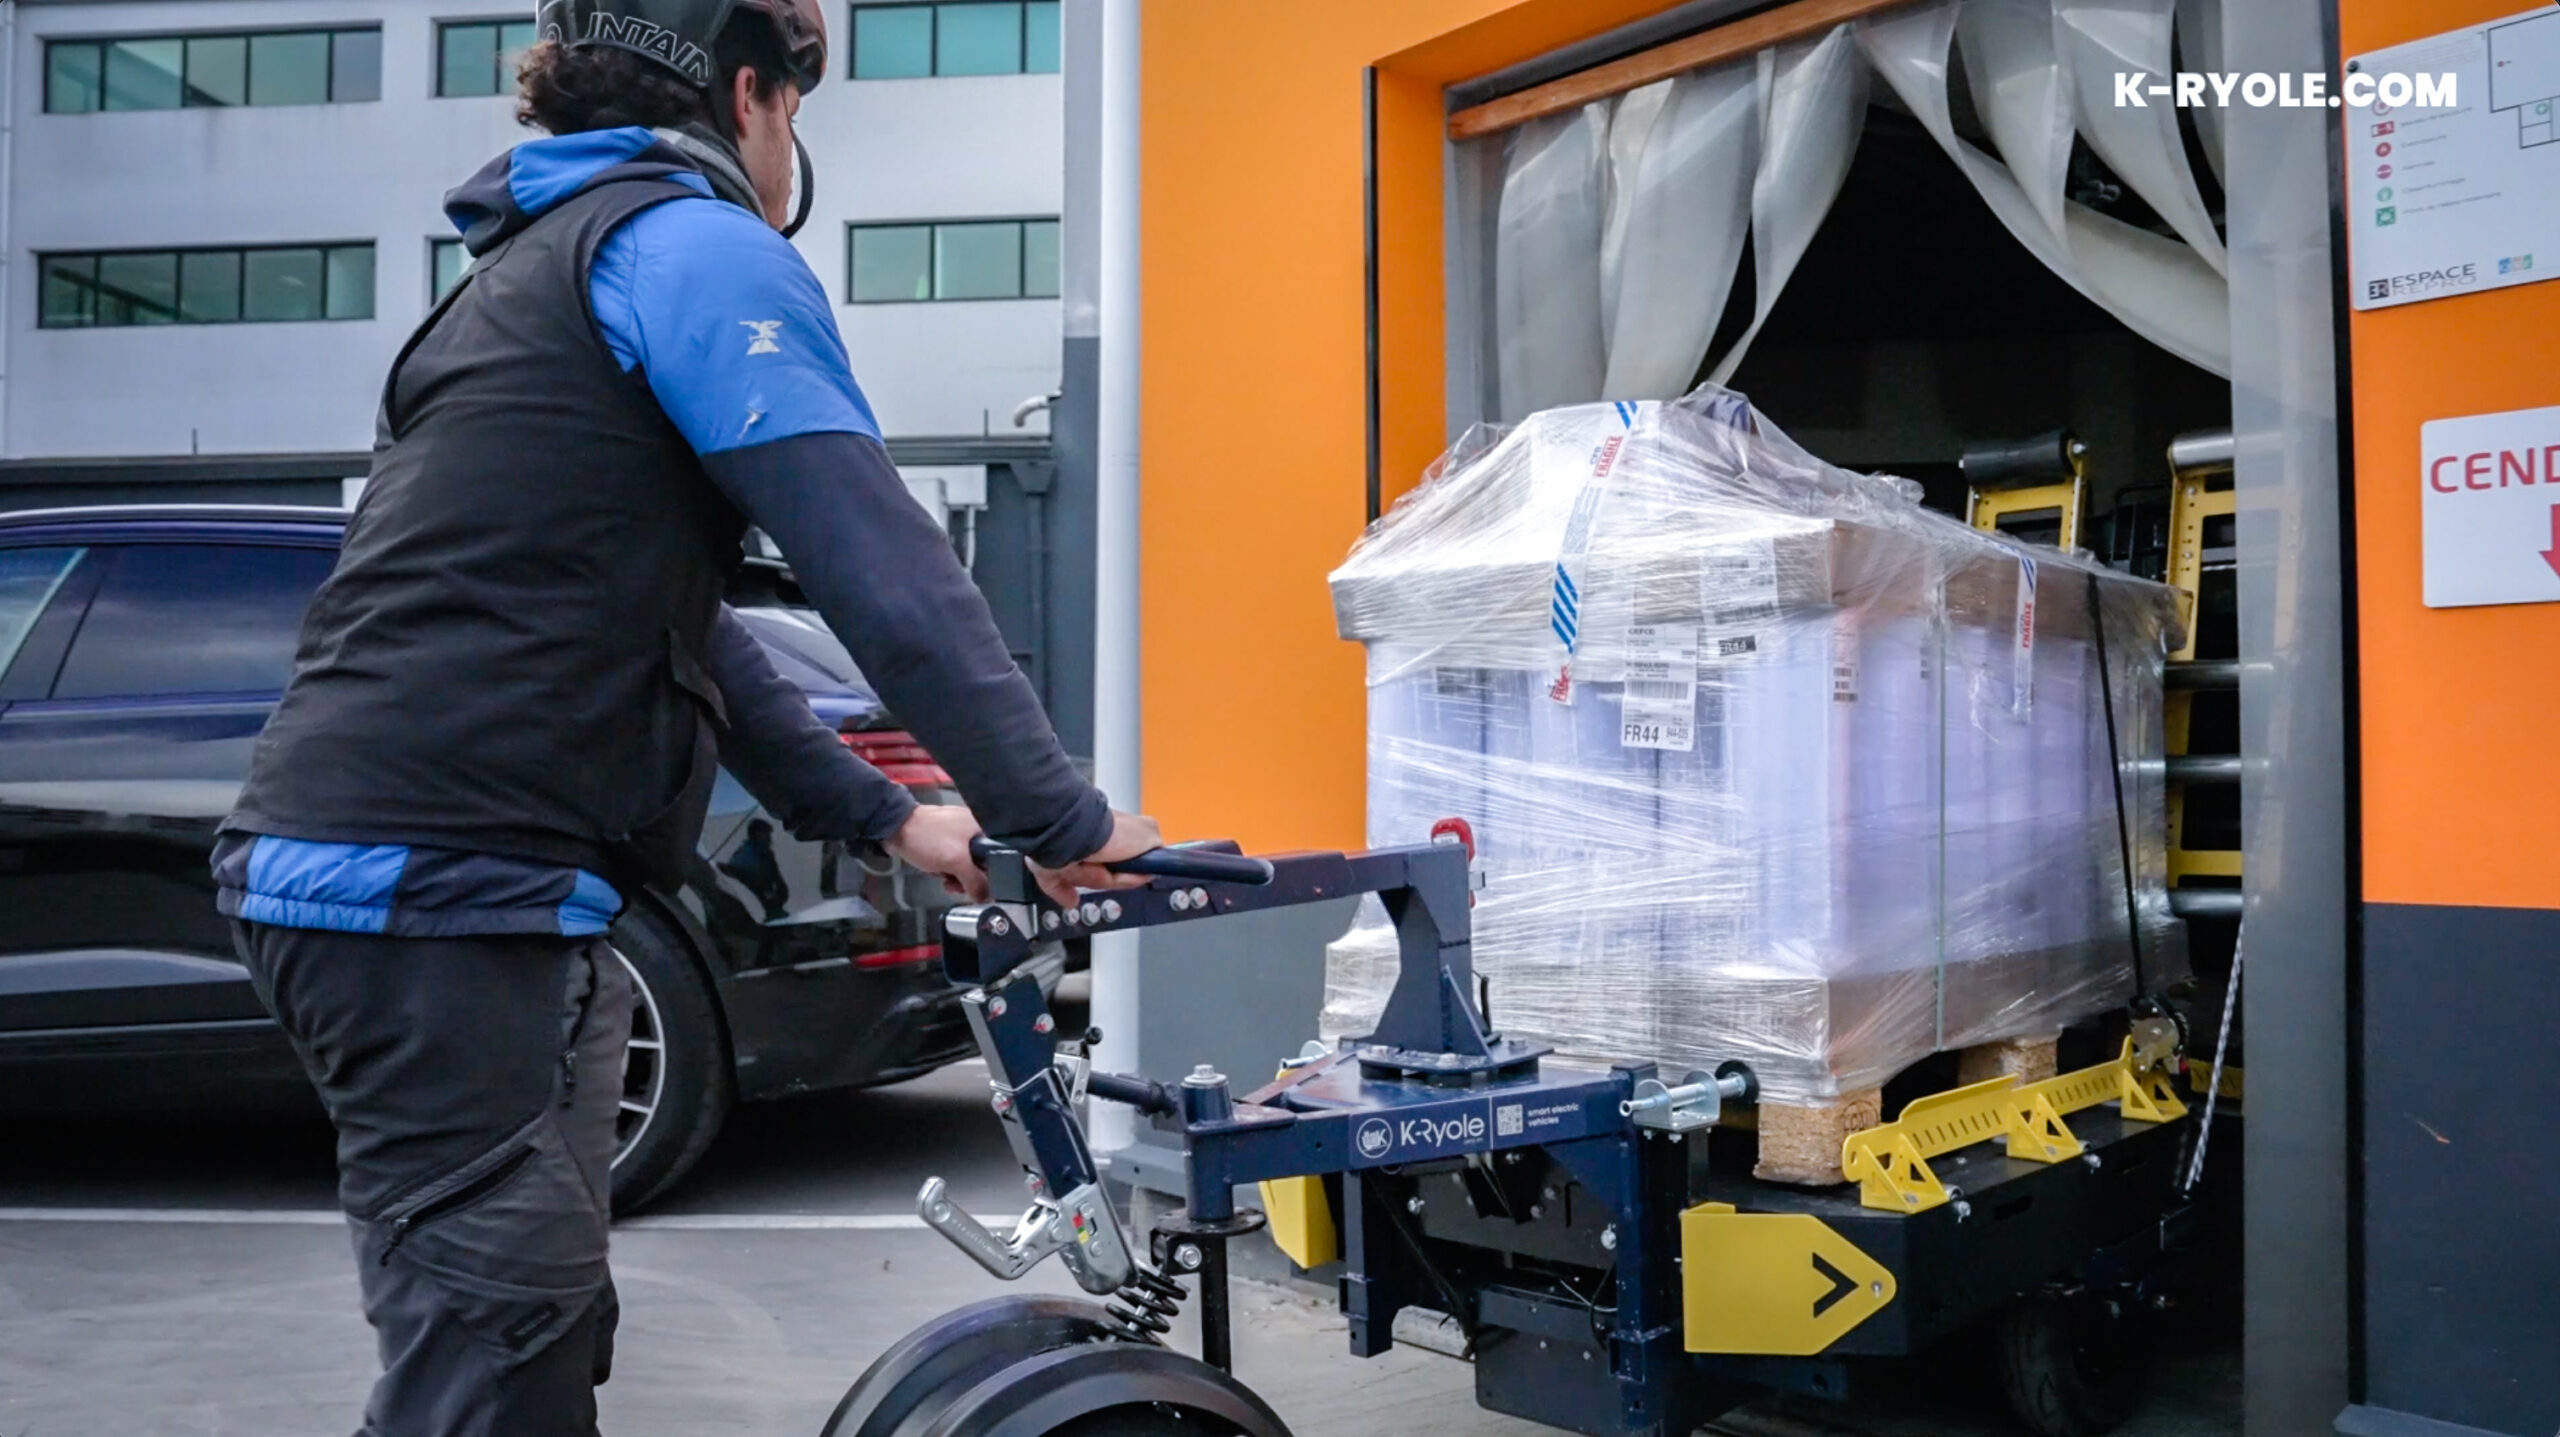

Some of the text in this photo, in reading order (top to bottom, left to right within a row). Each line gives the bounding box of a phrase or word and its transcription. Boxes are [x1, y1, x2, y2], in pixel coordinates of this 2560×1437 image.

[2392, 263, 2477, 288] ESPACE
[1593, 436, 1623, 478] FRAGILE
[2022, 602, 2033, 649] FRAGILE
[1624, 725, 1660, 742] FR44
[1528, 1103, 1579, 1117] smart electric
[1528, 1117, 1559, 1127] vehicles
[1400, 1113, 1485, 1148] K-Ryole
